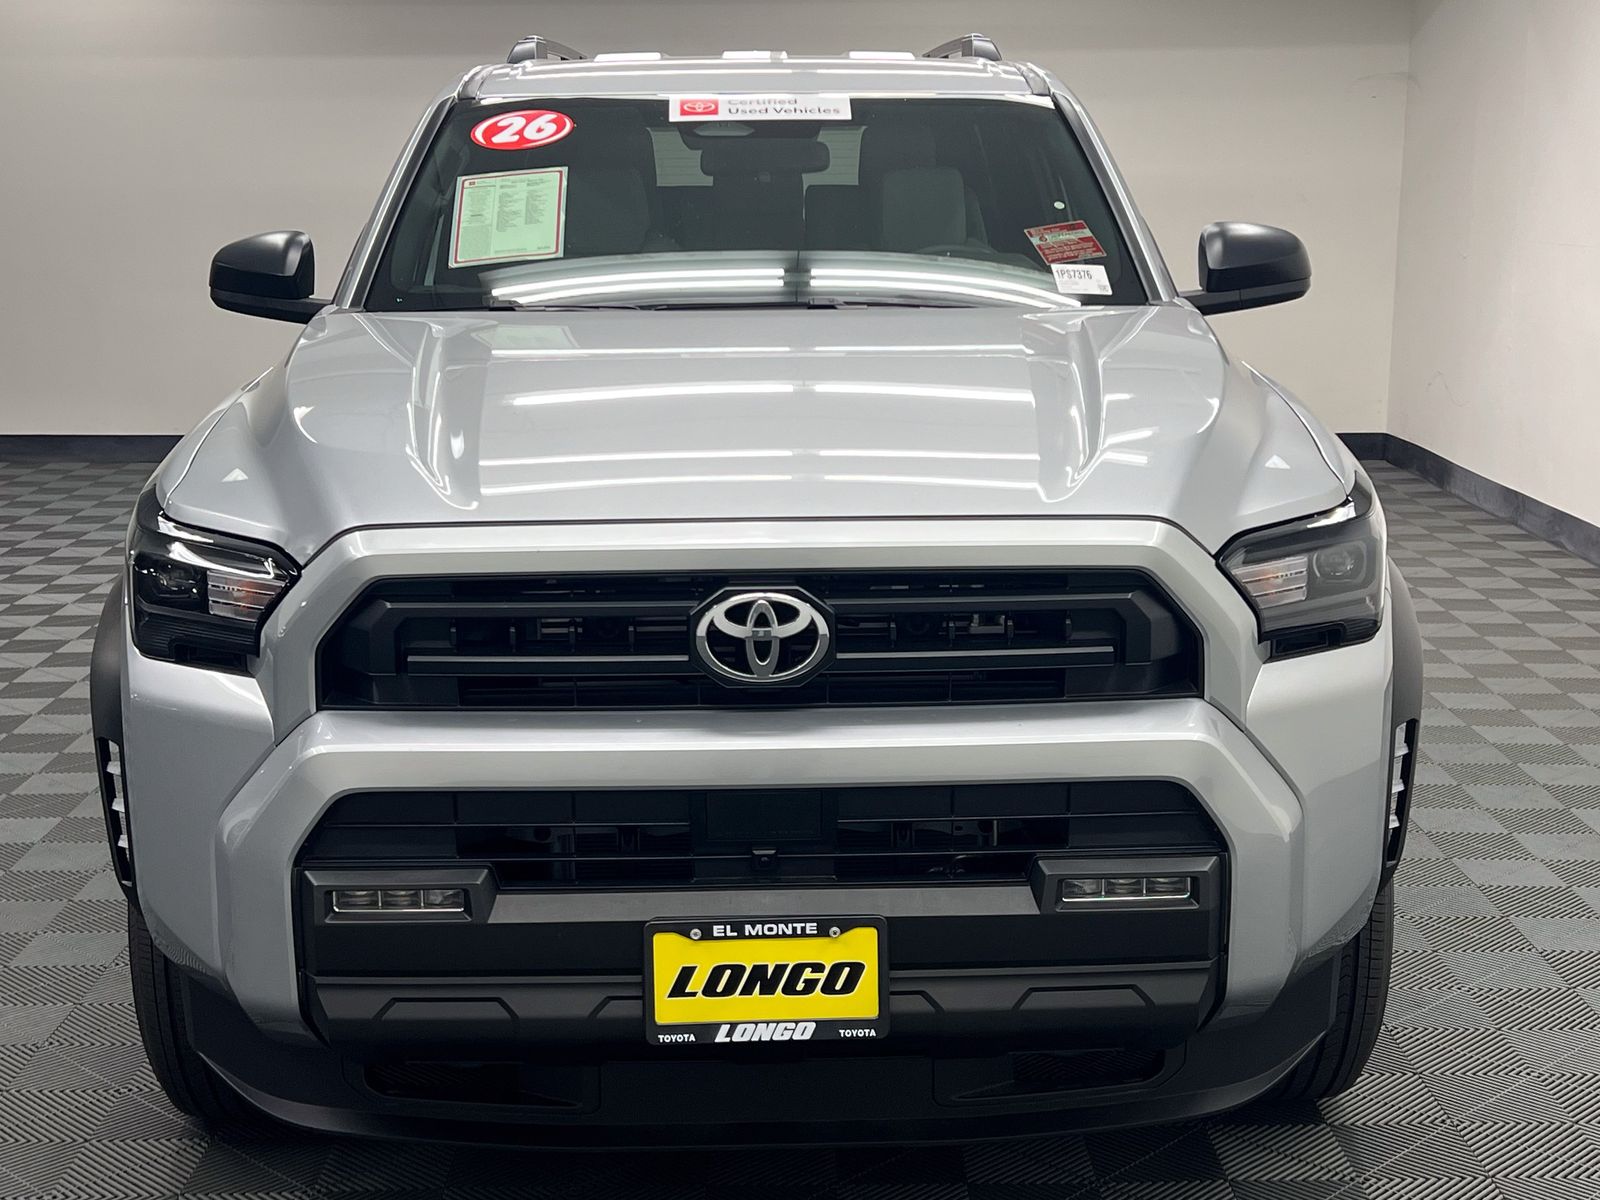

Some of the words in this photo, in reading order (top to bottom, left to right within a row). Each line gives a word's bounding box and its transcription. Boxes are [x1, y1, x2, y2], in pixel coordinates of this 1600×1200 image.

[727, 98, 798, 106] Certified
[728, 107, 769, 115] Used
[773, 107, 841, 115] Vehicles
[491, 114, 558, 144] 26
[713, 925, 738, 937] EL
[744, 923, 818, 936] MONTE
[667, 961, 866, 999] LONGO
[714, 1022, 817, 1043] LONGO
[839, 1029, 877, 1037] TOYOTA
[658, 1034, 696, 1043] TOYOTA
